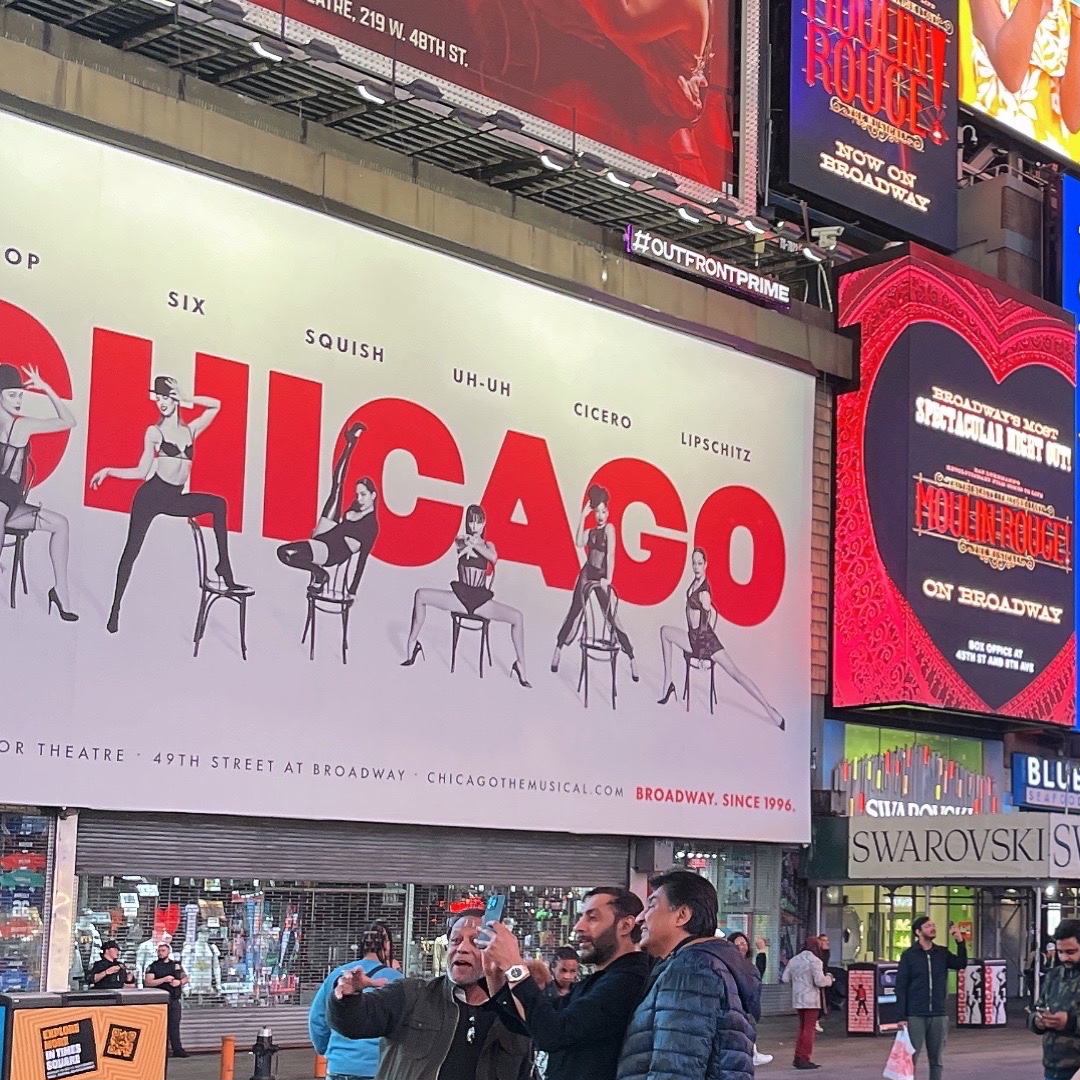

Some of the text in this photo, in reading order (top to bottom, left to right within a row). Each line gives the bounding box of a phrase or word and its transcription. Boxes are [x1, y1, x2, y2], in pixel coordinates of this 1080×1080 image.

[360, 7, 385, 33] 219
[389, 17, 406, 41] W.
[409, 28, 446, 58] 48TH
[449, 43, 469, 67] ST.
[819, 152, 931, 212] BROADWAY
[835, 140, 917, 188] NOW ON
[633, 229, 790, 303] #OUTFRONTPRIME
[168, 291, 206, 315] SIX
[305, 329, 384, 363] SQUISH
[453, 368, 511, 397] UH-UH
[574, 402, 632, 429] CICERO
[915, 396, 1073, 472] SPECTACULAR NIGHT OUT!
[932, 386, 1060, 441] BROADWAY'S MOST
[681, 432, 751, 463] LIPSCHITZ
[915, 481, 996, 546] MOULIN
[1000, 505, 1072, 565] ROUGE!
[922, 578, 1063, 624] ON BROADWAY
[986, 643, 1012, 656] OFFICE
[37, 742, 125, 762] THEATRE
[153, 752, 200, 767] 49TH
[211, 756, 274, 773] STREET
[284, 761, 303, 775] AT
[312, 763, 406, 781] BROADWAY
[427, 771, 624, 797] CHICAGOTHEMUSICAL.COM
[635, 786, 796, 812] BROADWAY. SINCE 1996.
[853, 828, 1045, 863] SWAROVSKI
